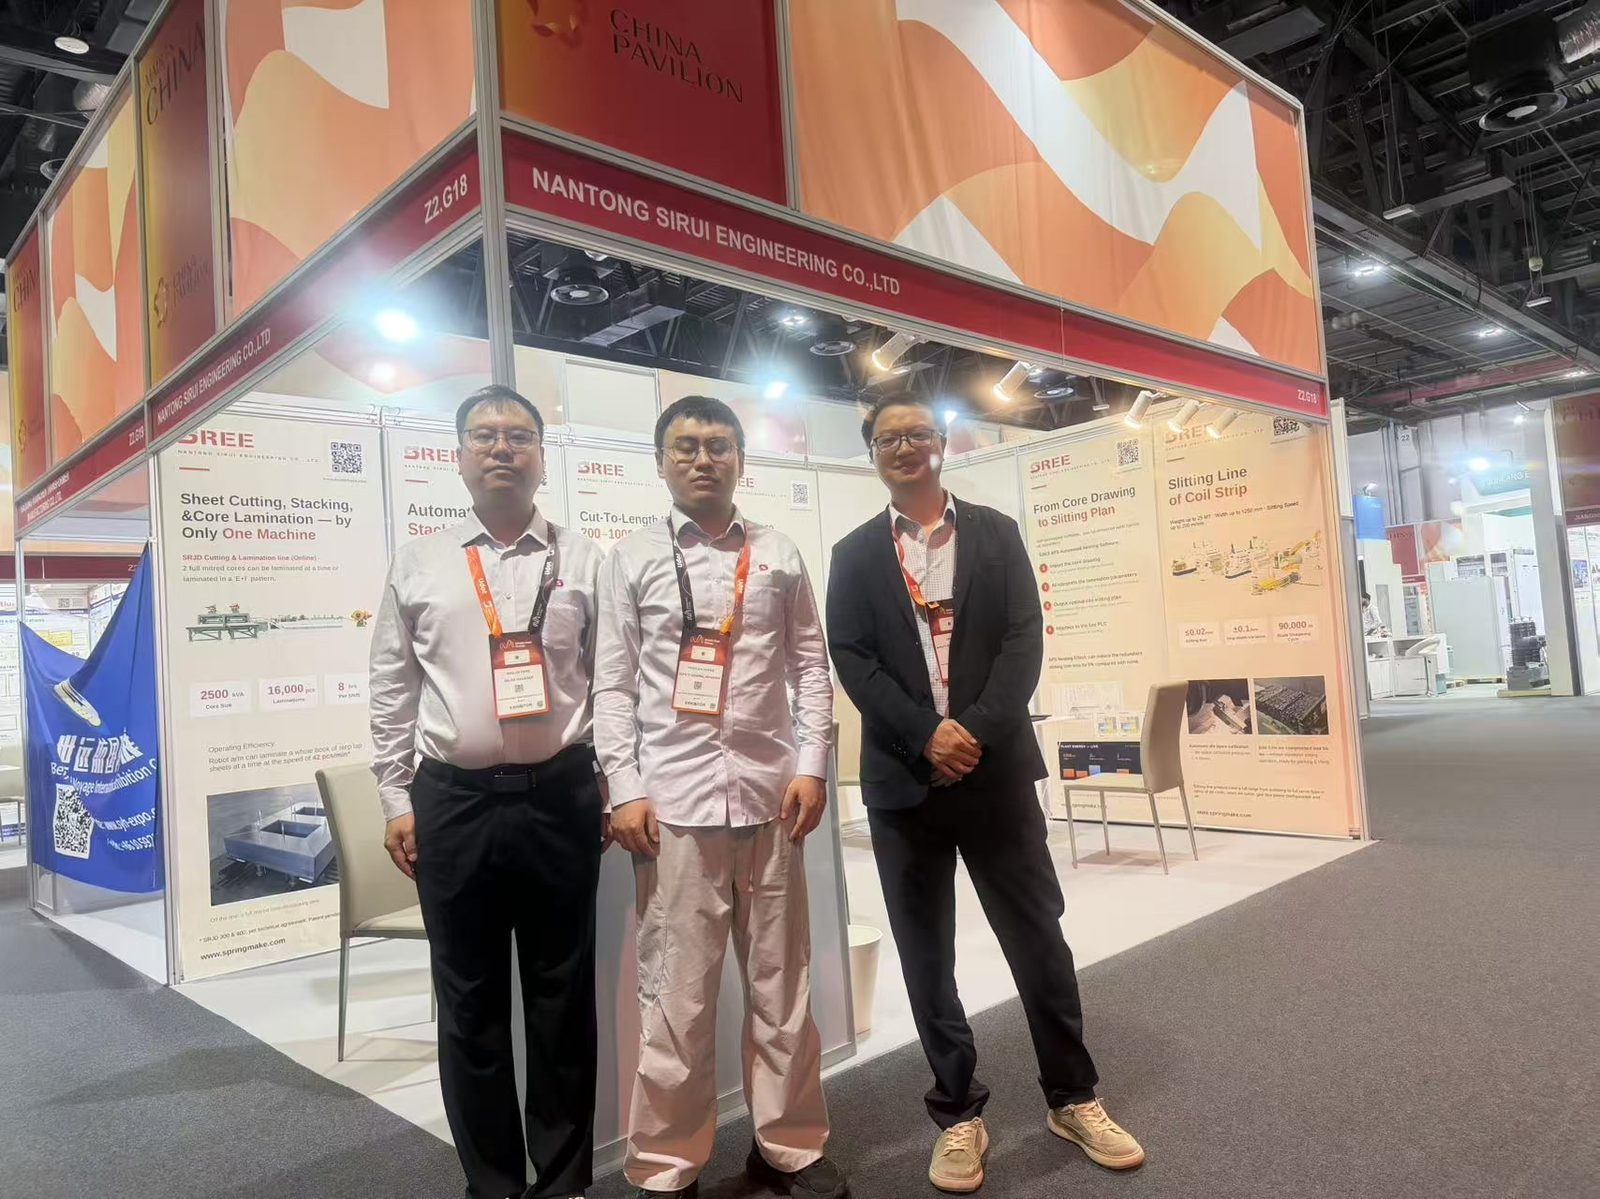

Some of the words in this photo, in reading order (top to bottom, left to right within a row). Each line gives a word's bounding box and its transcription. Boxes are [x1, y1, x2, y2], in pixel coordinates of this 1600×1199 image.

[610, 8, 702, 64] CHINA
[613, 34, 743, 104] PAVILION
[424, 173, 468, 224] Z2.G18
[532, 167, 650, 221] NANTONG
[656, 206, 710, 241] SIRUI
[716, 226, 838, 278] ENGINEERING
[842, 263, 901, 295] CO.,LTD
[156, 395, 183, 425] NANTONG
[183, 385, 199, 406] SIRUI
[199, 350, 242, 393] ENGINEERING
[242, 327, 271, 361] CO.,LTD
[577, 460, 625, 477] SREE
[1030, 454, 1072, 474] SREE
[1168, 474, 1214, 491] Slitting
[1217, 466, 1248, 481] Line
[180, 493, 226, 506] Sheet
[228, 494, 287, 511] Cutting,
[290, 497, 353, 512] Stacking,
[1033, 501, 1060, 514] From
[1062, 496, 1088, 509] Core
[1090, 486, 1136, 503] Drawing
[1168, 495, 1182, 506] of
[1184, 489, 1211, 503] Coil
[1214, 484, 1249, 499] Strip
[181, 510, 230, 523] &Core
[234, 511, 314, 525] Lamination
[335, 514, 352, 528] by
[579, 511, 658, 528] Cut-To-Length
[1038, 517, 1049, 528] to
[1050, 511, 1089, 526] Slitting
[1090, 505, 1116, 518] Plan
[181, 526, 219, 542] Only
[222, 527, 253, 540] One
[256, 527, 317, 541] Machine
[203, 554, 231, 563] Cutting
[231, 554, 237, 562] &
[238, 554, 276, 562] Lamination
[183, 575, 219, 583] laminated
[219, 575, 227, 583] in
[200, 689, 229, 701] 2500
[267, 684, 304, 697] 16,000
[337, 682, 345, 691] 8
[208, 743, 242, 754] Operating
[242, 741, 276, 751] Efficiency
[208, 756, 230, 765] Robot
[230, 755, 245, 763] arm
[245, 754, 259, 762] can
[259, 750, 288, 761] laminate
[209, 763, 232, 773] sheets
[247, 760, 262, 769] time
[271, 758, 283, 766] the
[199, 936, 287, 961] www.springmake.com
